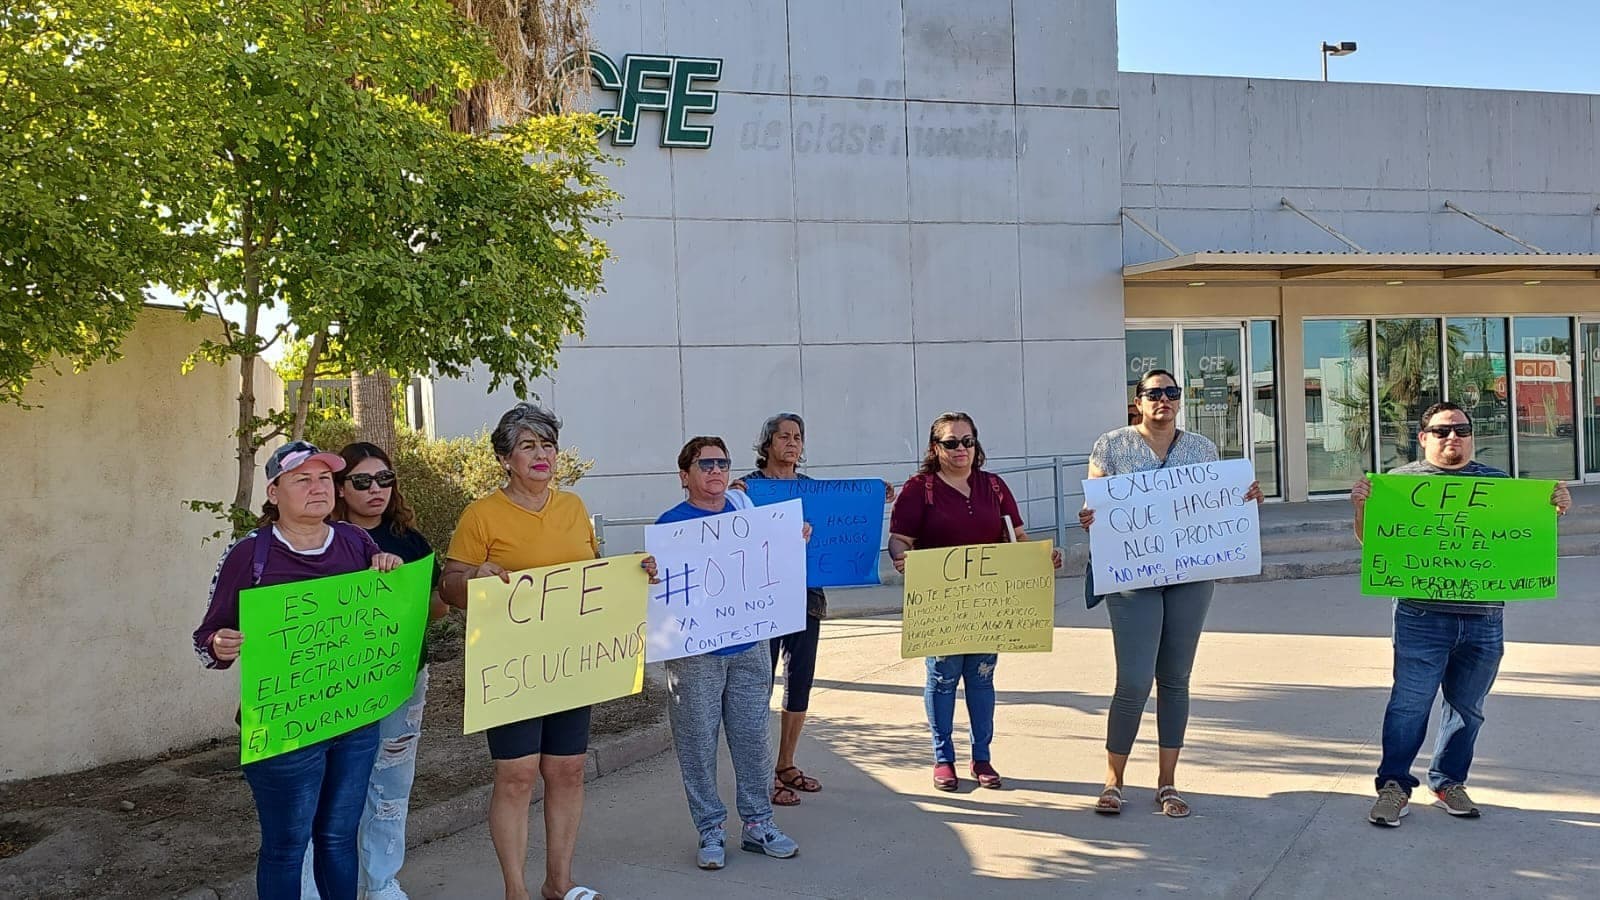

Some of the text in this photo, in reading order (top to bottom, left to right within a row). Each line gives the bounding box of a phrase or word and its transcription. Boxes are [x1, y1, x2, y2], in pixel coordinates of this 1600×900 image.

[549, 50, 723, 149] CFE
[1130, 357, 1158, 373] CFE
[1199, 356, 1226, 371] CFE
[1107, 464, 1219, 501] EXIGIMOS
[1109, 486, 1246, 534] QUE HAGAS
[1434, 511, 1470, 527] TE
[1123, 518, 1250, 561] ALGO PRONTO
[1377, 524, 1533, 541] NECESITAMOS
[1438, 540, 1490, 551] EN EL
[655, 540, 781, 607] #071
[943, 546, 998, 582] CFE
[1138, 564, 1166, 579] MAS
[284, 577, 393, 622] ES UNA
[508, 561, 609, 625] CFE
[906, 590, 923, 606] NO
[944, 580, 999, 599] ESTAMOS
[1369, 574, 1404, 587] LAS
[1411, 576, 1479, 592] PERSONAS
[1481, 579, 1505, 591] DEL
[676, 595, 775, 632] YA NO NOS
[955, 599, 969, 610] TE
[268, 607, 390, 650] TORTURA
[289, 622, 399, 666] ESTAR SIN
[684, 620, 778, 654] CONTESTA
[257, 642, 401, 701] ELECTRICIDAD
[481, 621, 647, 705] ESCUCHANOS
[281, 694, 390, 741] DURANGO
